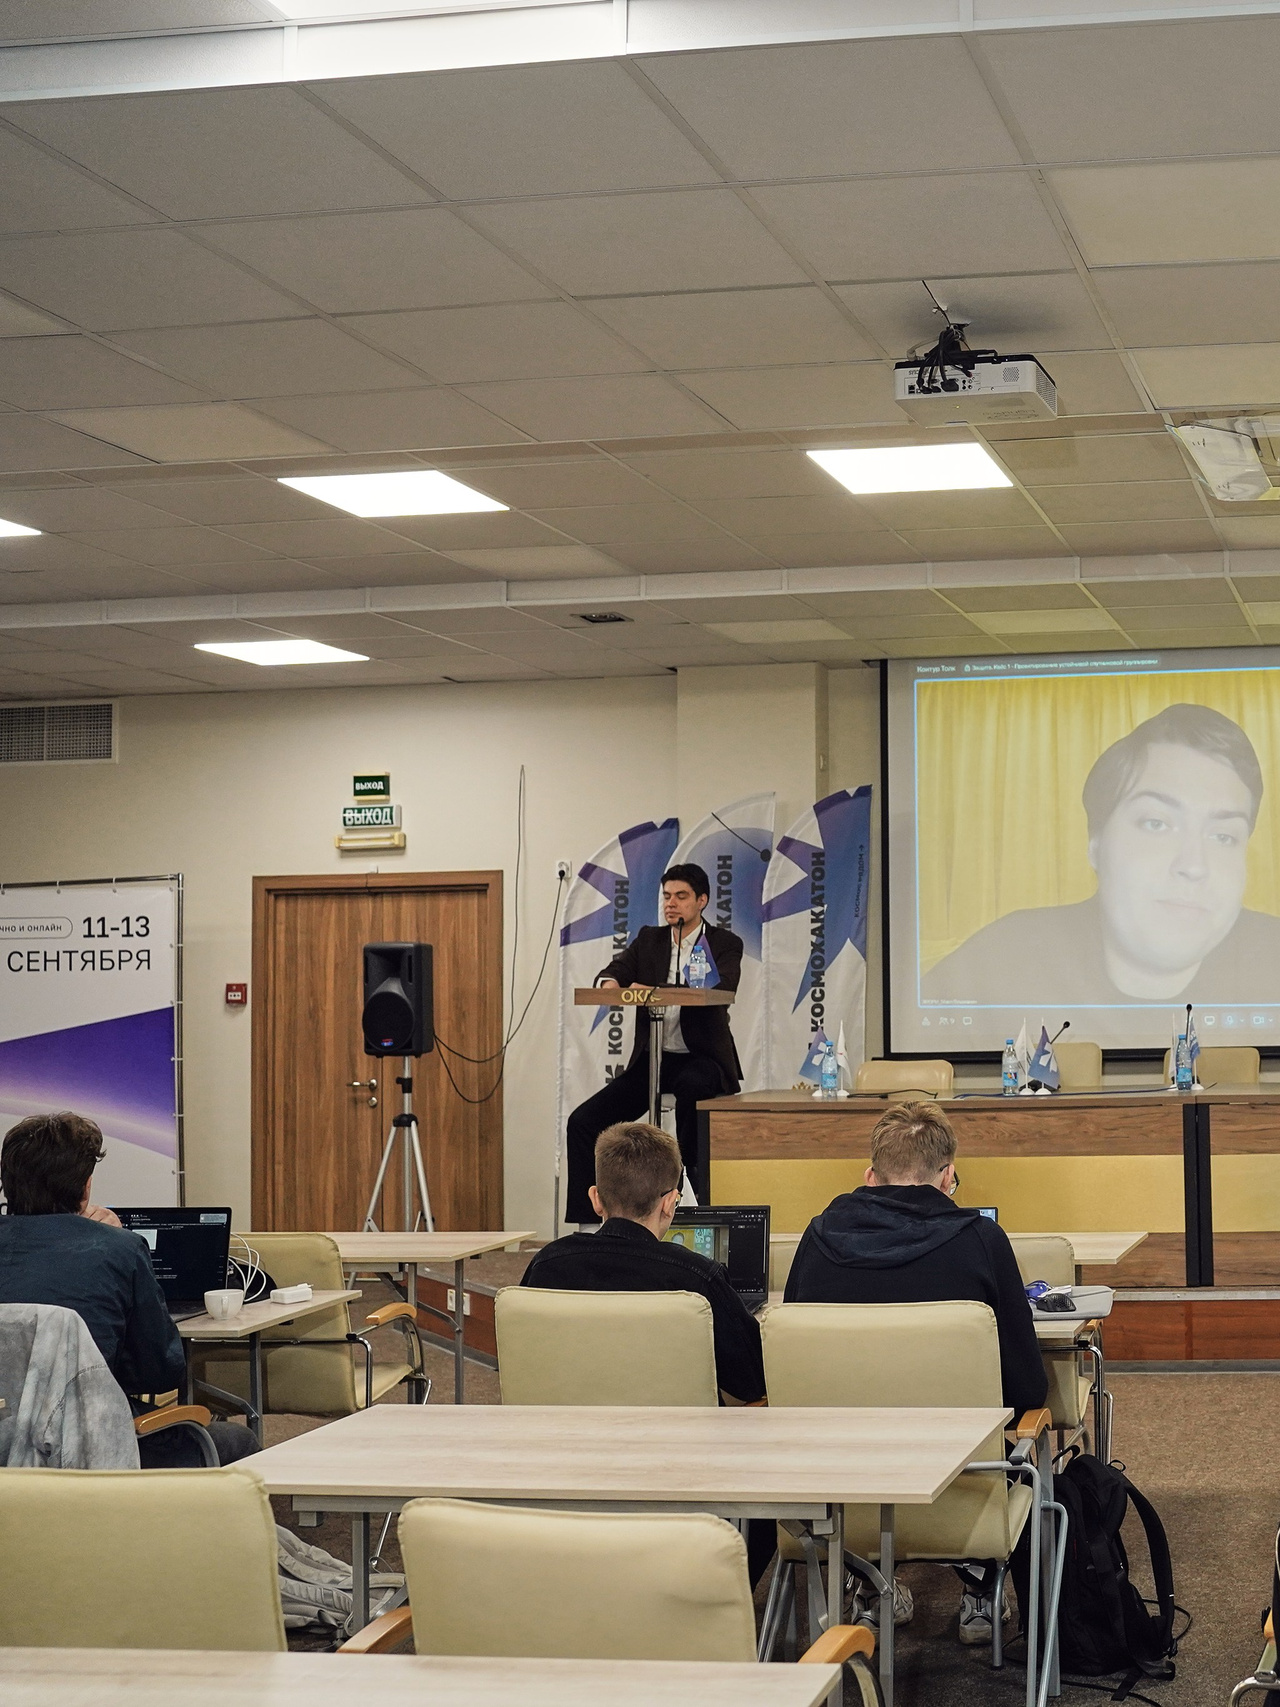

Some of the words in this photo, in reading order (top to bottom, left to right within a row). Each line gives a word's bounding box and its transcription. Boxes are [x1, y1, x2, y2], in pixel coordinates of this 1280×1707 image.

[917, 665, 940, 674] Контур
[355, 781, 384, 790] ВЫХОД
[345, 807, 392, 825] ВЫХОД
[716, 854, 733, 933] КАТОН
[27, 923, 62, 932] ОНЛАЙН
[82, 915, 150, 938] 11-13
[810, 851, 826, 1032] КОСМОХАКАТОН
[7, 948, 151, 972] СЕНТЯБРЯ
